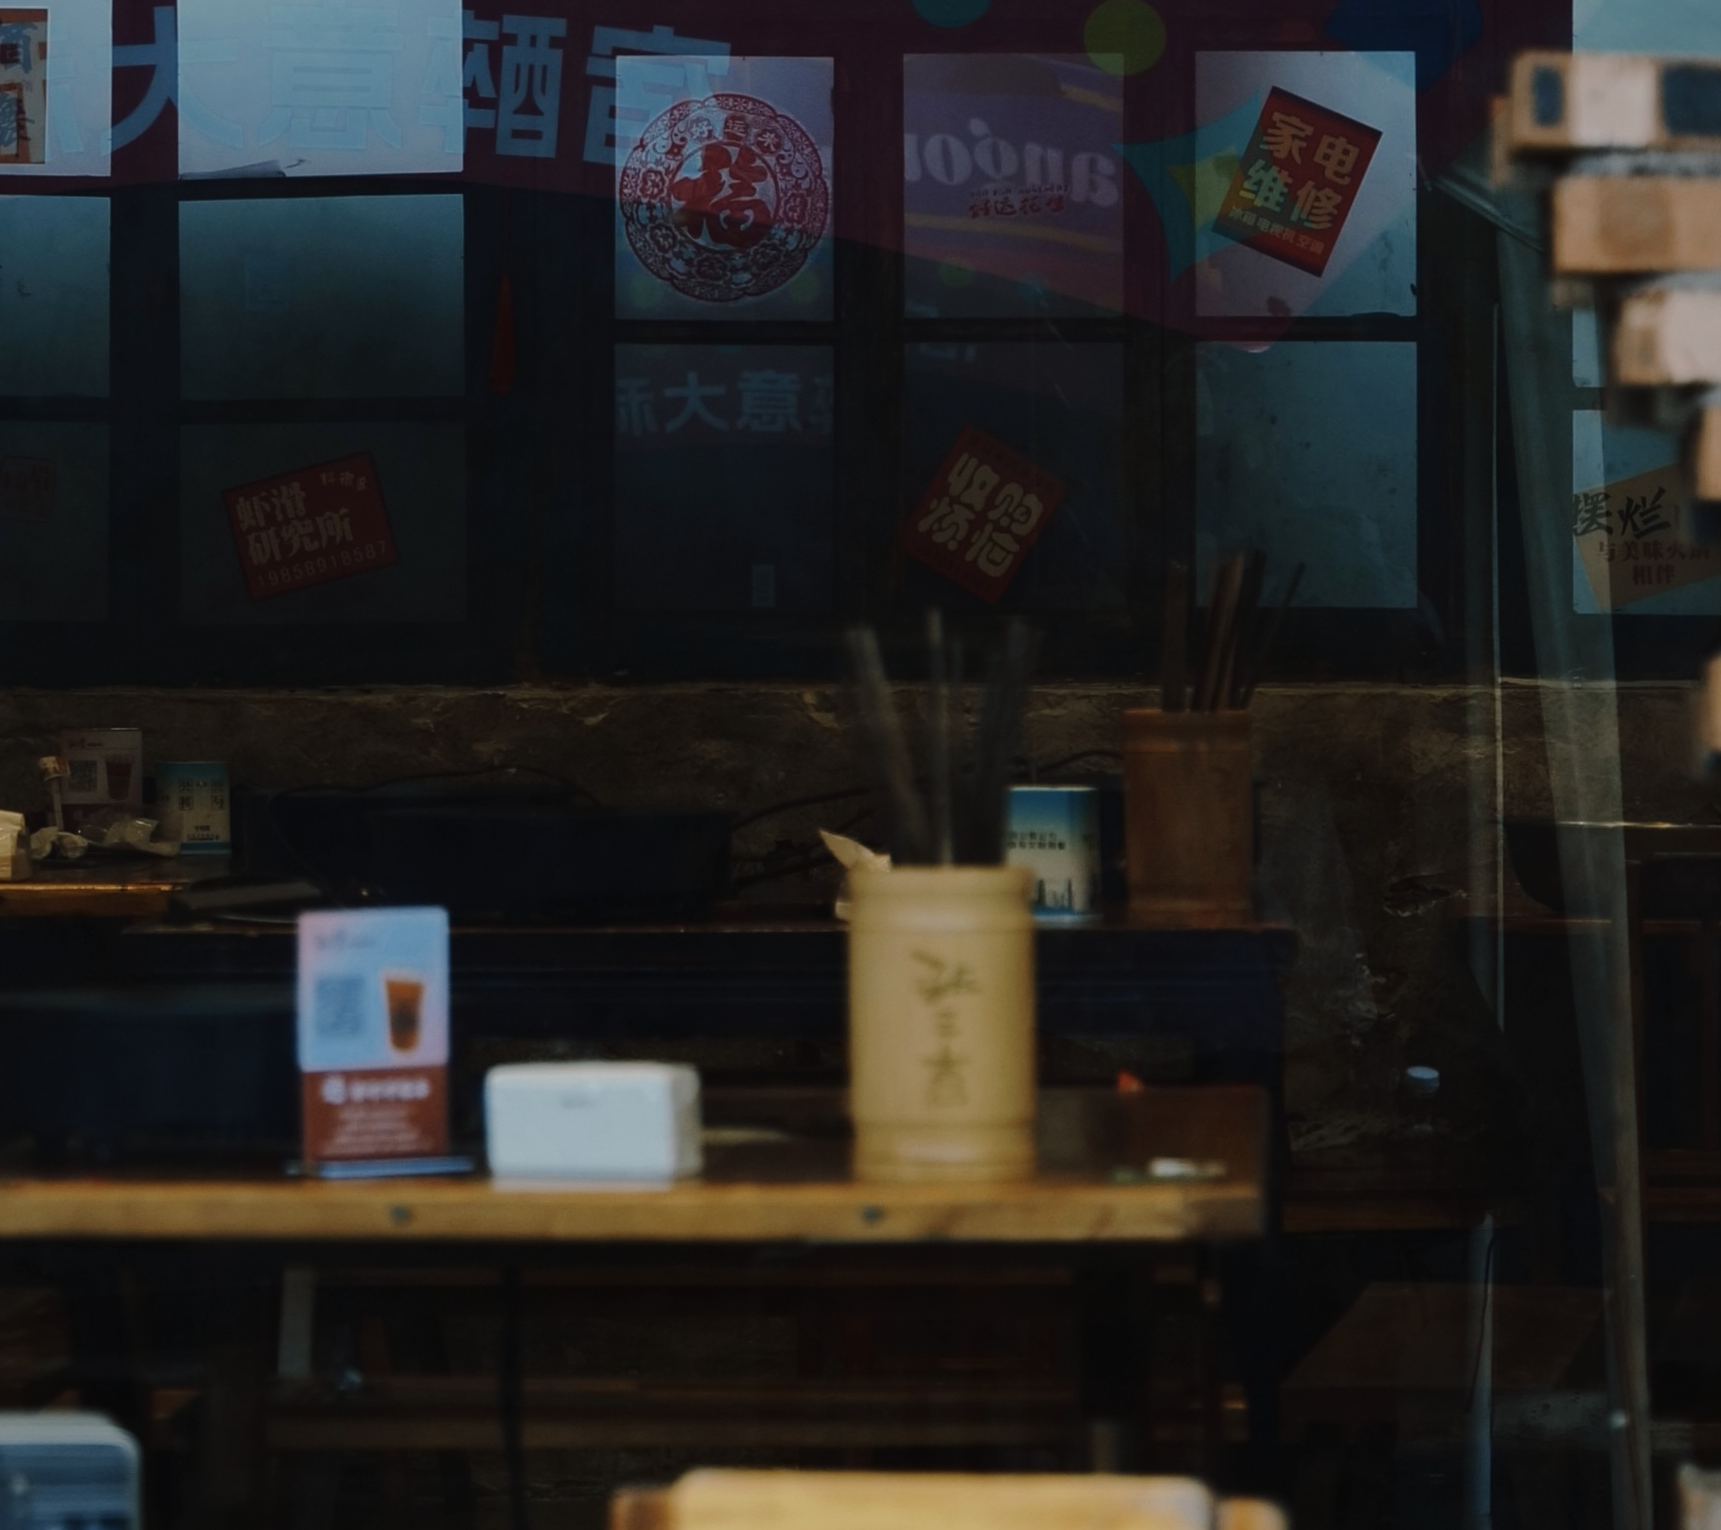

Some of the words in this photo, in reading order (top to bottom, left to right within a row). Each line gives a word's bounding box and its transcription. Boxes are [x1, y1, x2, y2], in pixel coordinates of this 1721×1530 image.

[1258, 111, 1361, 186] 家电
[669, 142, 773, 249] 福
[1238, 158, 1343, 230] 维修
[235, 481, 307, 533] 虾滑
[947, 452, 1045, 537] 收购
[246, 507, 354, 567] 研究所
[917, 496, 1021, 579] 烦恼
